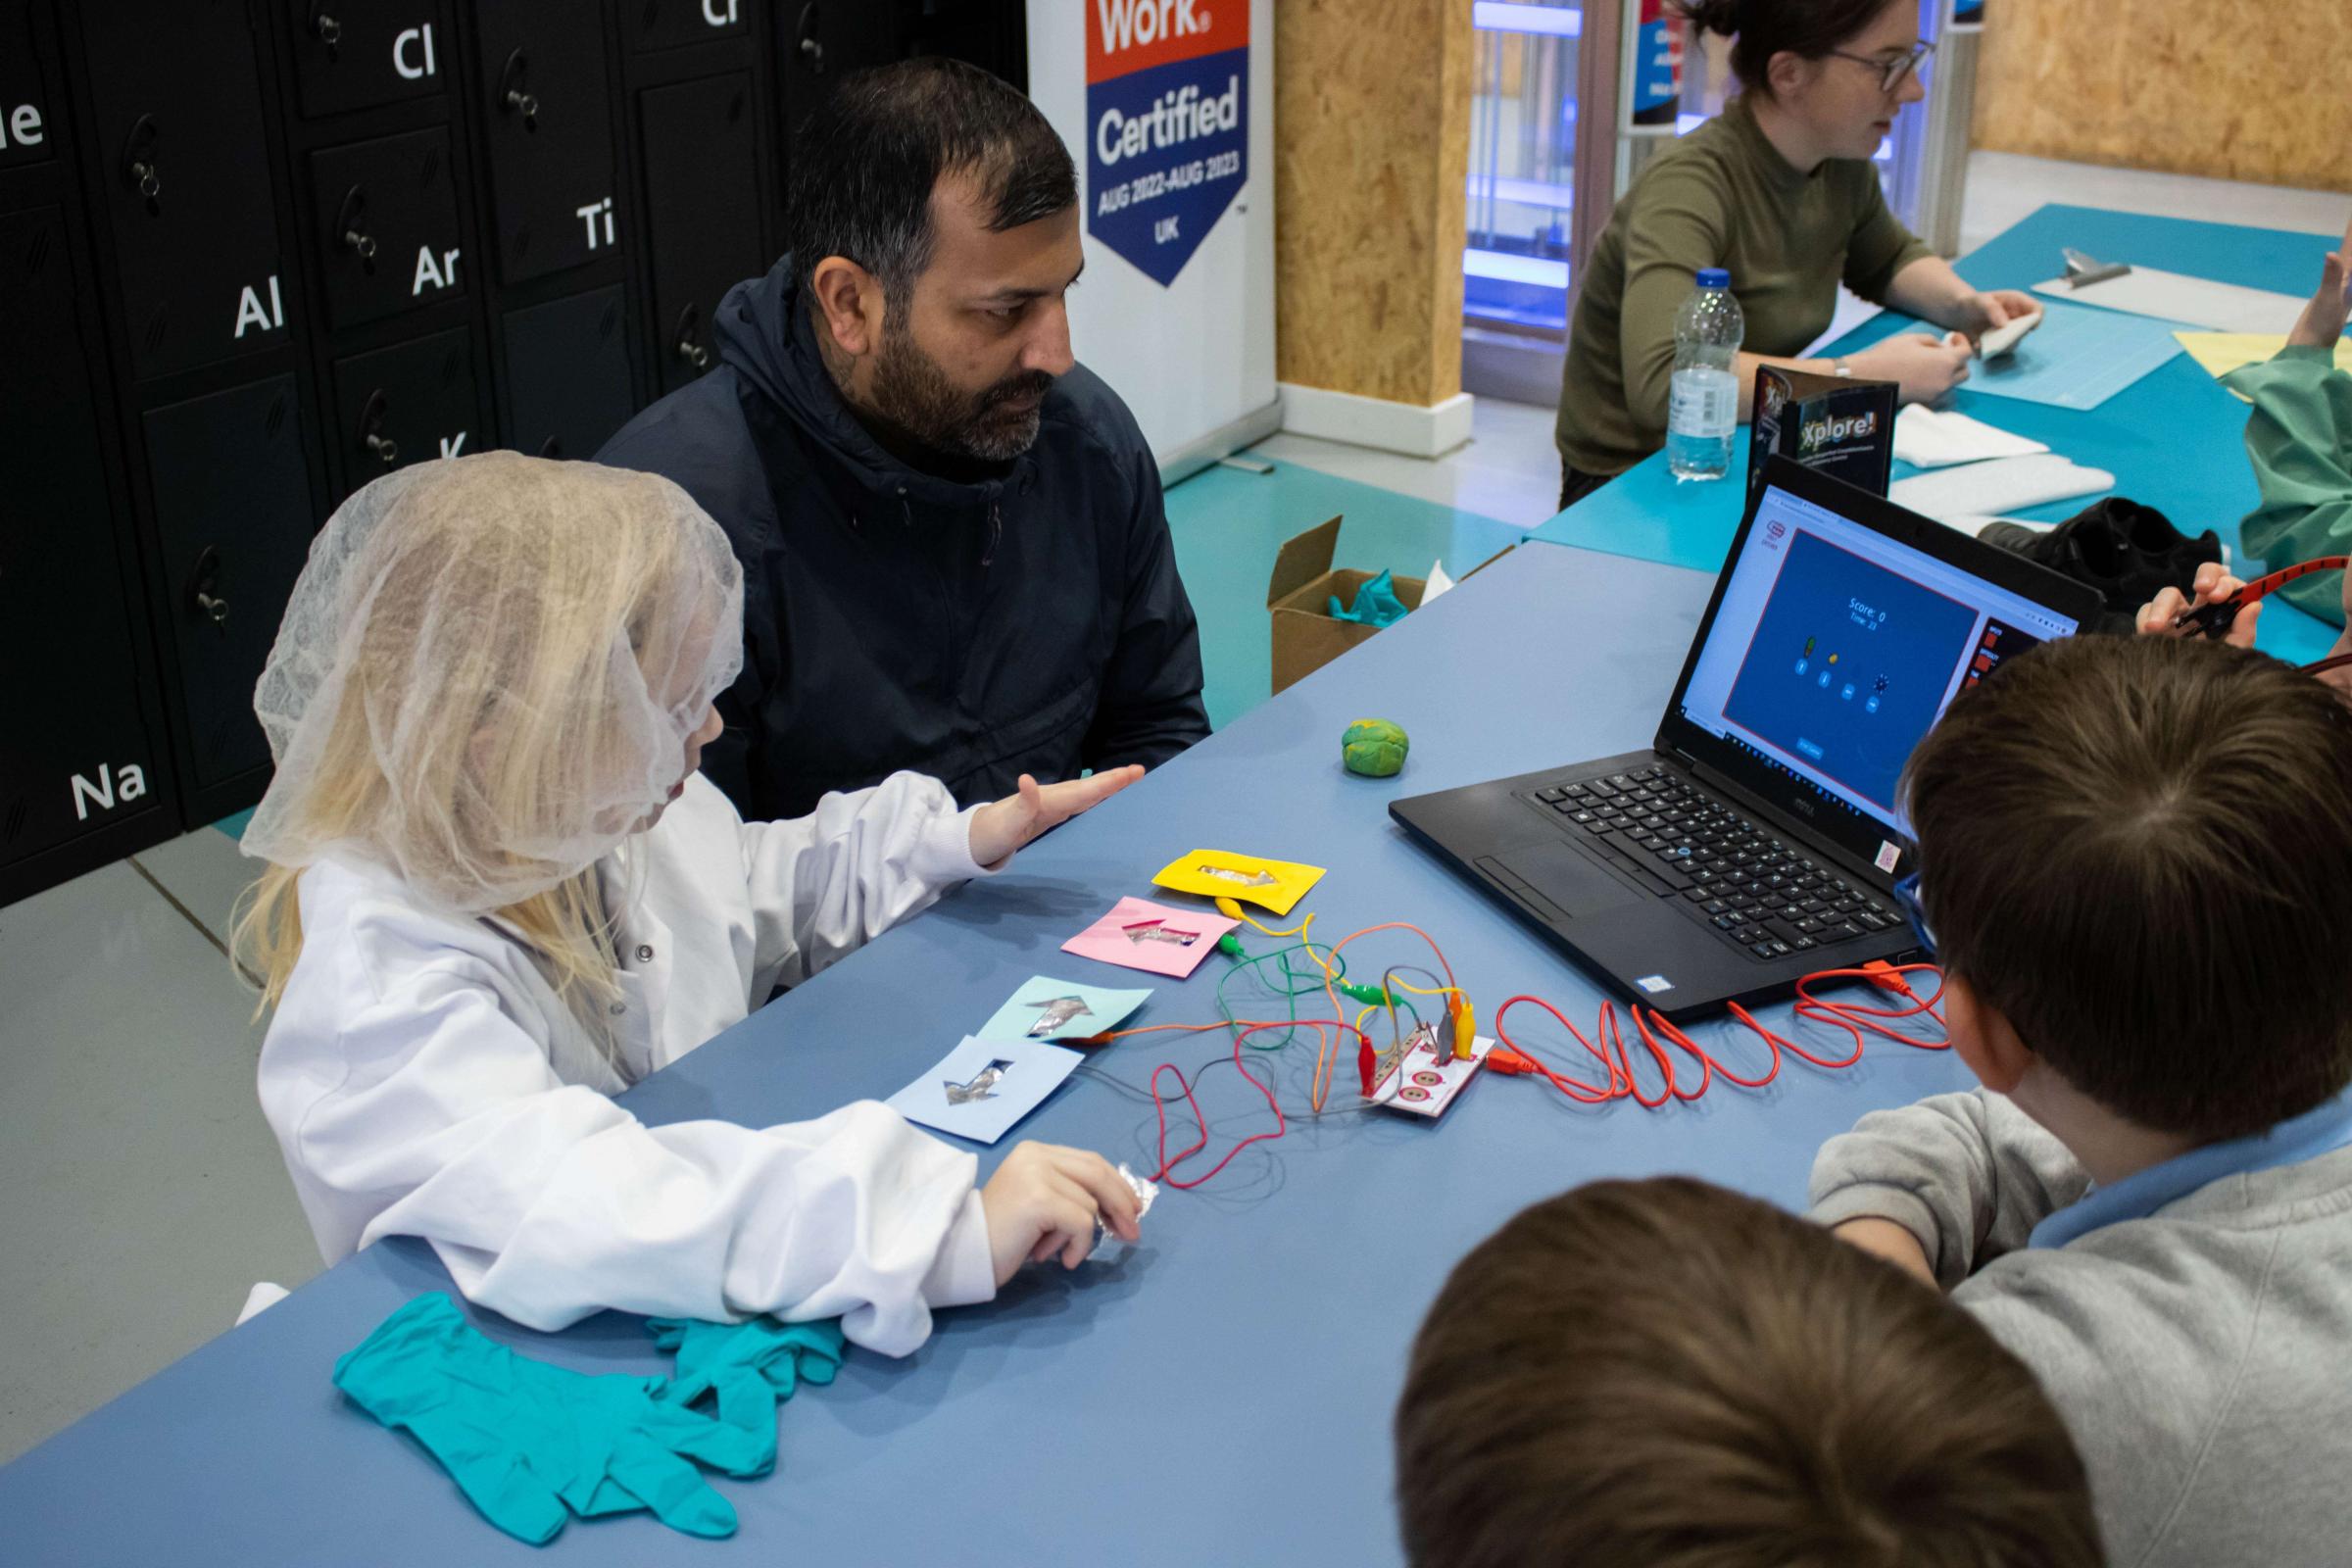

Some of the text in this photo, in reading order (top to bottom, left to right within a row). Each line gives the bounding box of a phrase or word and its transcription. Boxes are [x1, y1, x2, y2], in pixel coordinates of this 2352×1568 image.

[393, 24, 435, 79] Cl
[0, 104, 43, 149] e
[1096, 74, 1239, 166] Certified
[1098, 149, 1240, 217] AUG 2022-AUG 2023
[576, 197, 614, 250] Ti
[1154, 215, 1180, 244] UK
[412, 246, 461, 295] Ar
[233, 275, 283, 338] Al
[1848, 597, 1886, 623] Score: 0
[71, 762, 146, 820] Na
